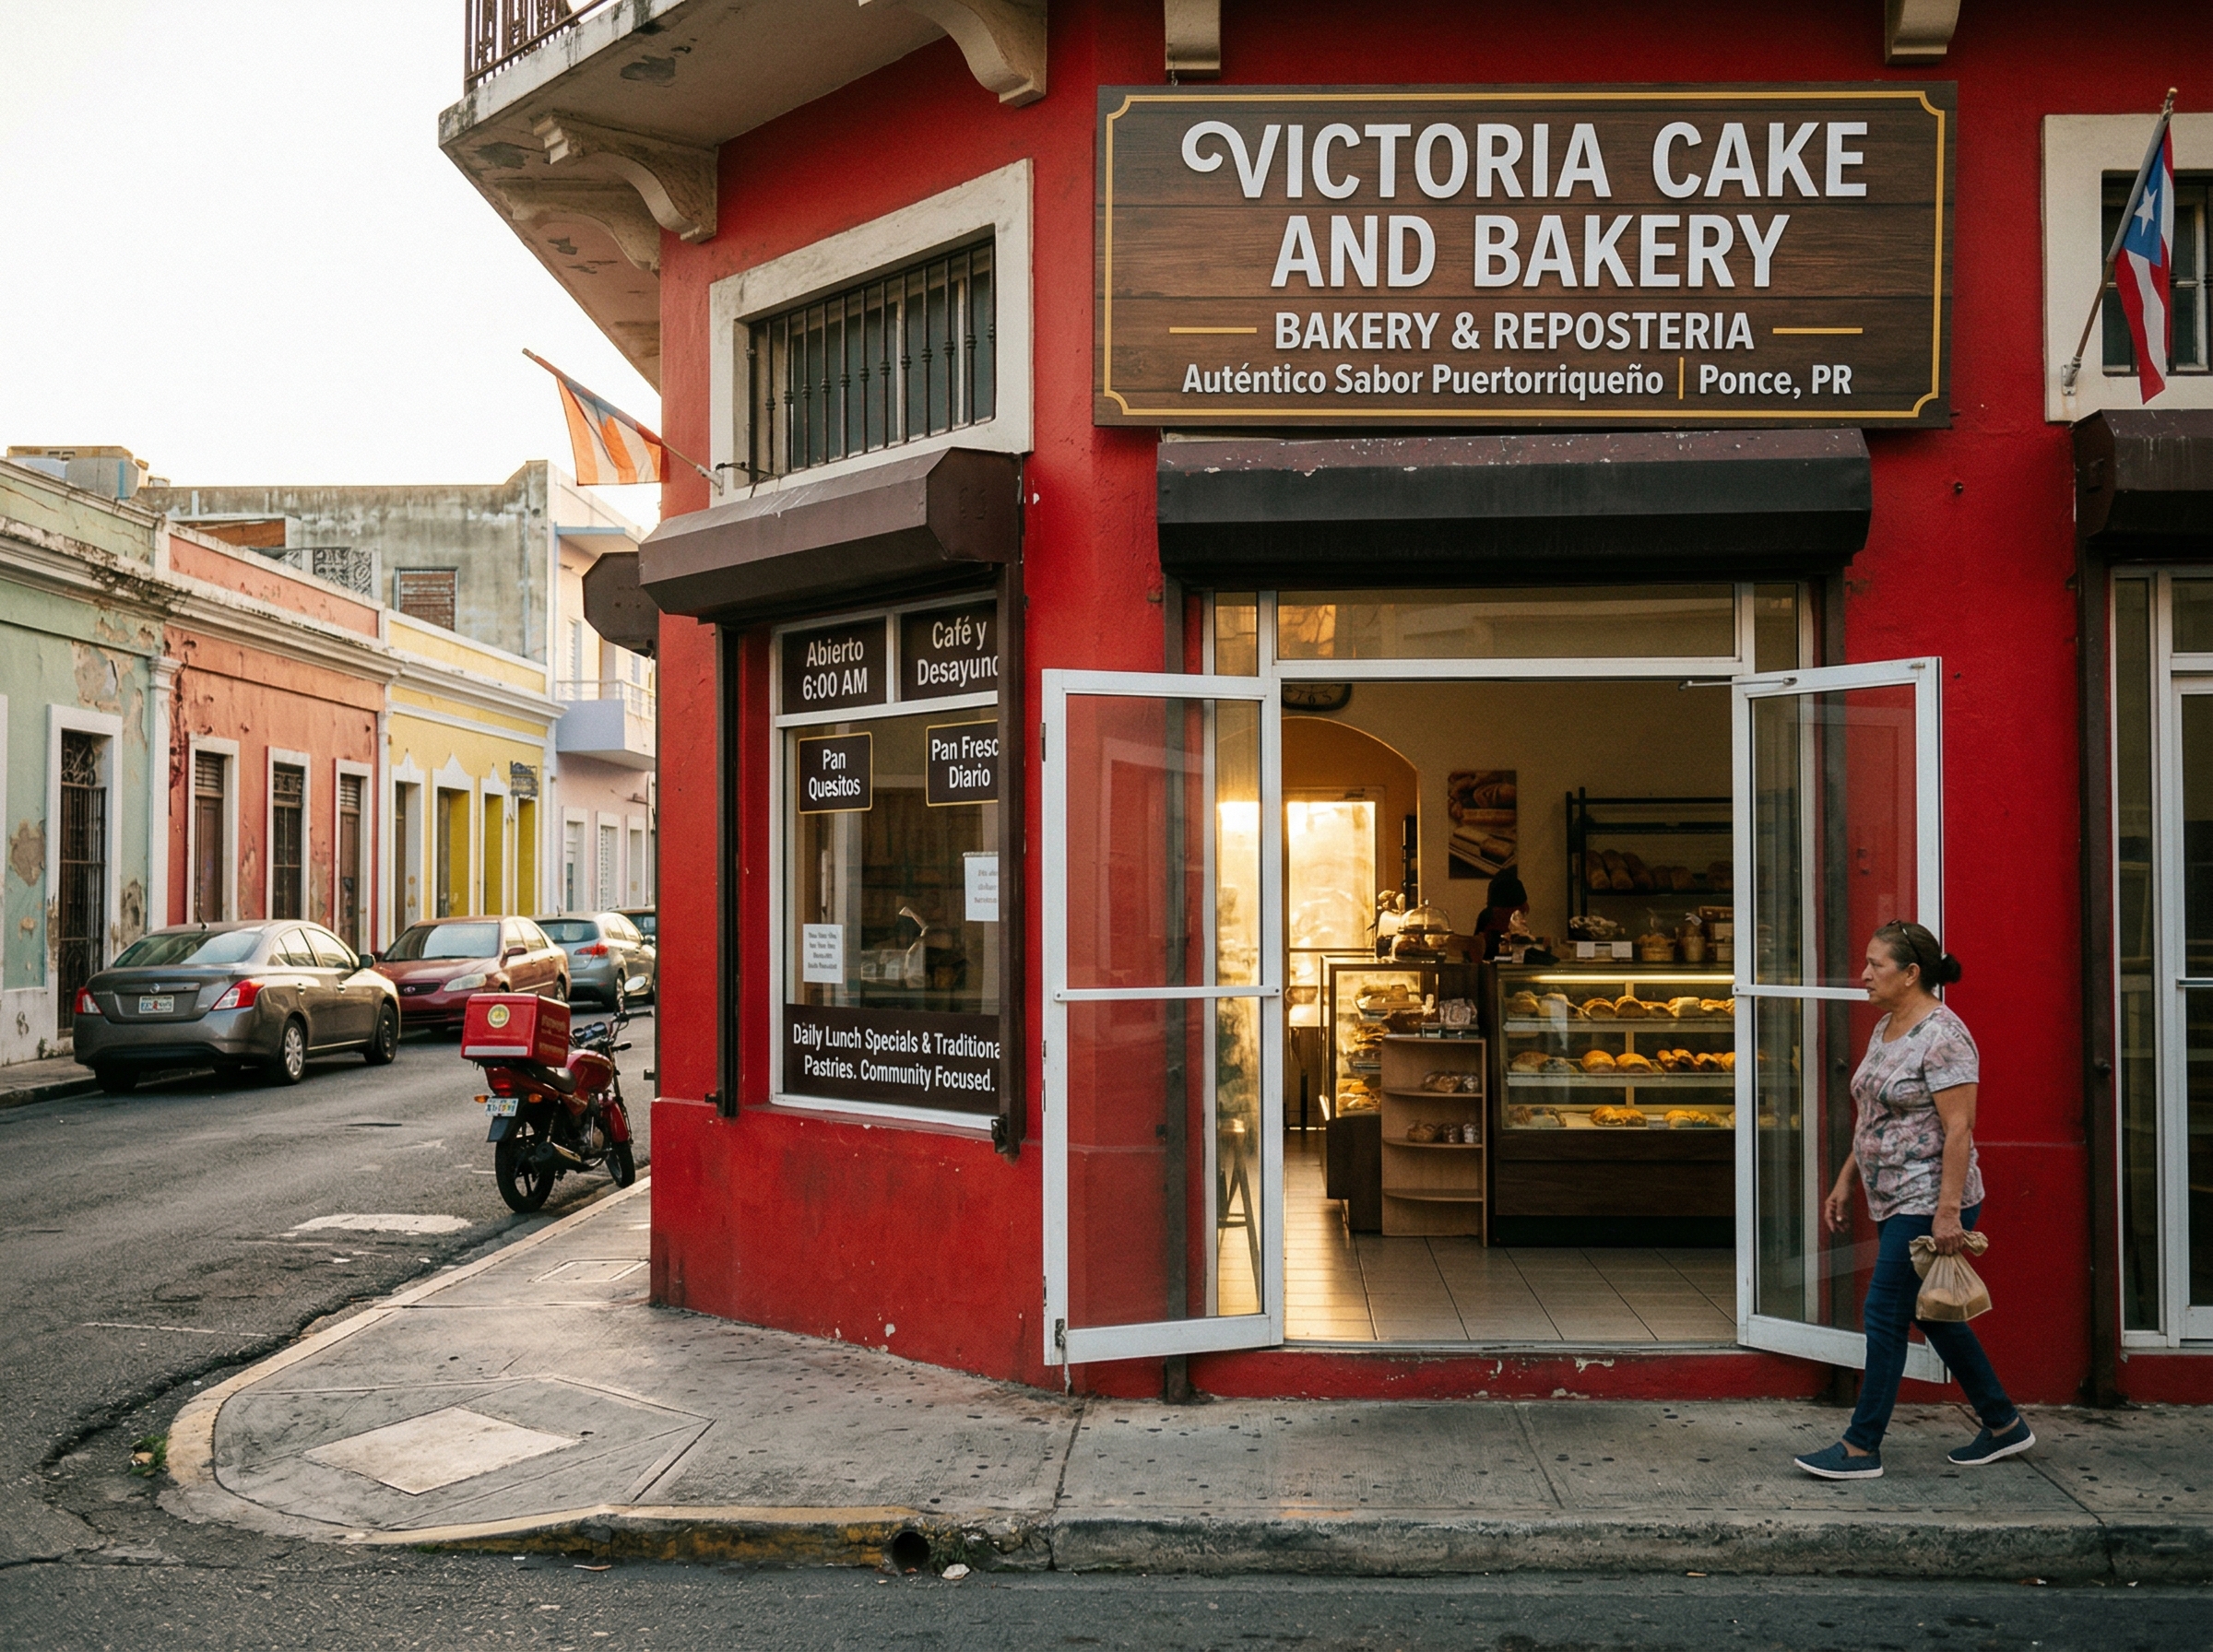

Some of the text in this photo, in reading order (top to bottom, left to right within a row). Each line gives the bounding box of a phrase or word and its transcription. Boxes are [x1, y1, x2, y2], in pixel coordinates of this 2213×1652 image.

[1182, 121, 1868, 200] VICTORIA CAKE
[1272, 215, 1791, 289] AND BAKERY
[1276, 313, 1756, 351] BAKERY & REPOSTERIA
[1183, 363, 1853, 402] Auténtico Sabor Puertorriqueño Ponce, PR
[932, 616, 988, 651] Café y
[806, 637, 864, 667] Abierto
[802, 667, 868, 701] 6:00 AM
[822, 749, 846, 771] Pan
[931, 738, 958, 761] Pan
[808, 774, 861, 801] Quesitos
[949, 762, 991, 789] Diario
[793, 1023, 822, 1051] Daily
[825, 1025, 861, 1049] Lunch
[865, 1028, 918, 1056] Specials
[921, 1032, 931, 1054] &
[804, 1055, 996, 1092] Pastries. Community Focused.
